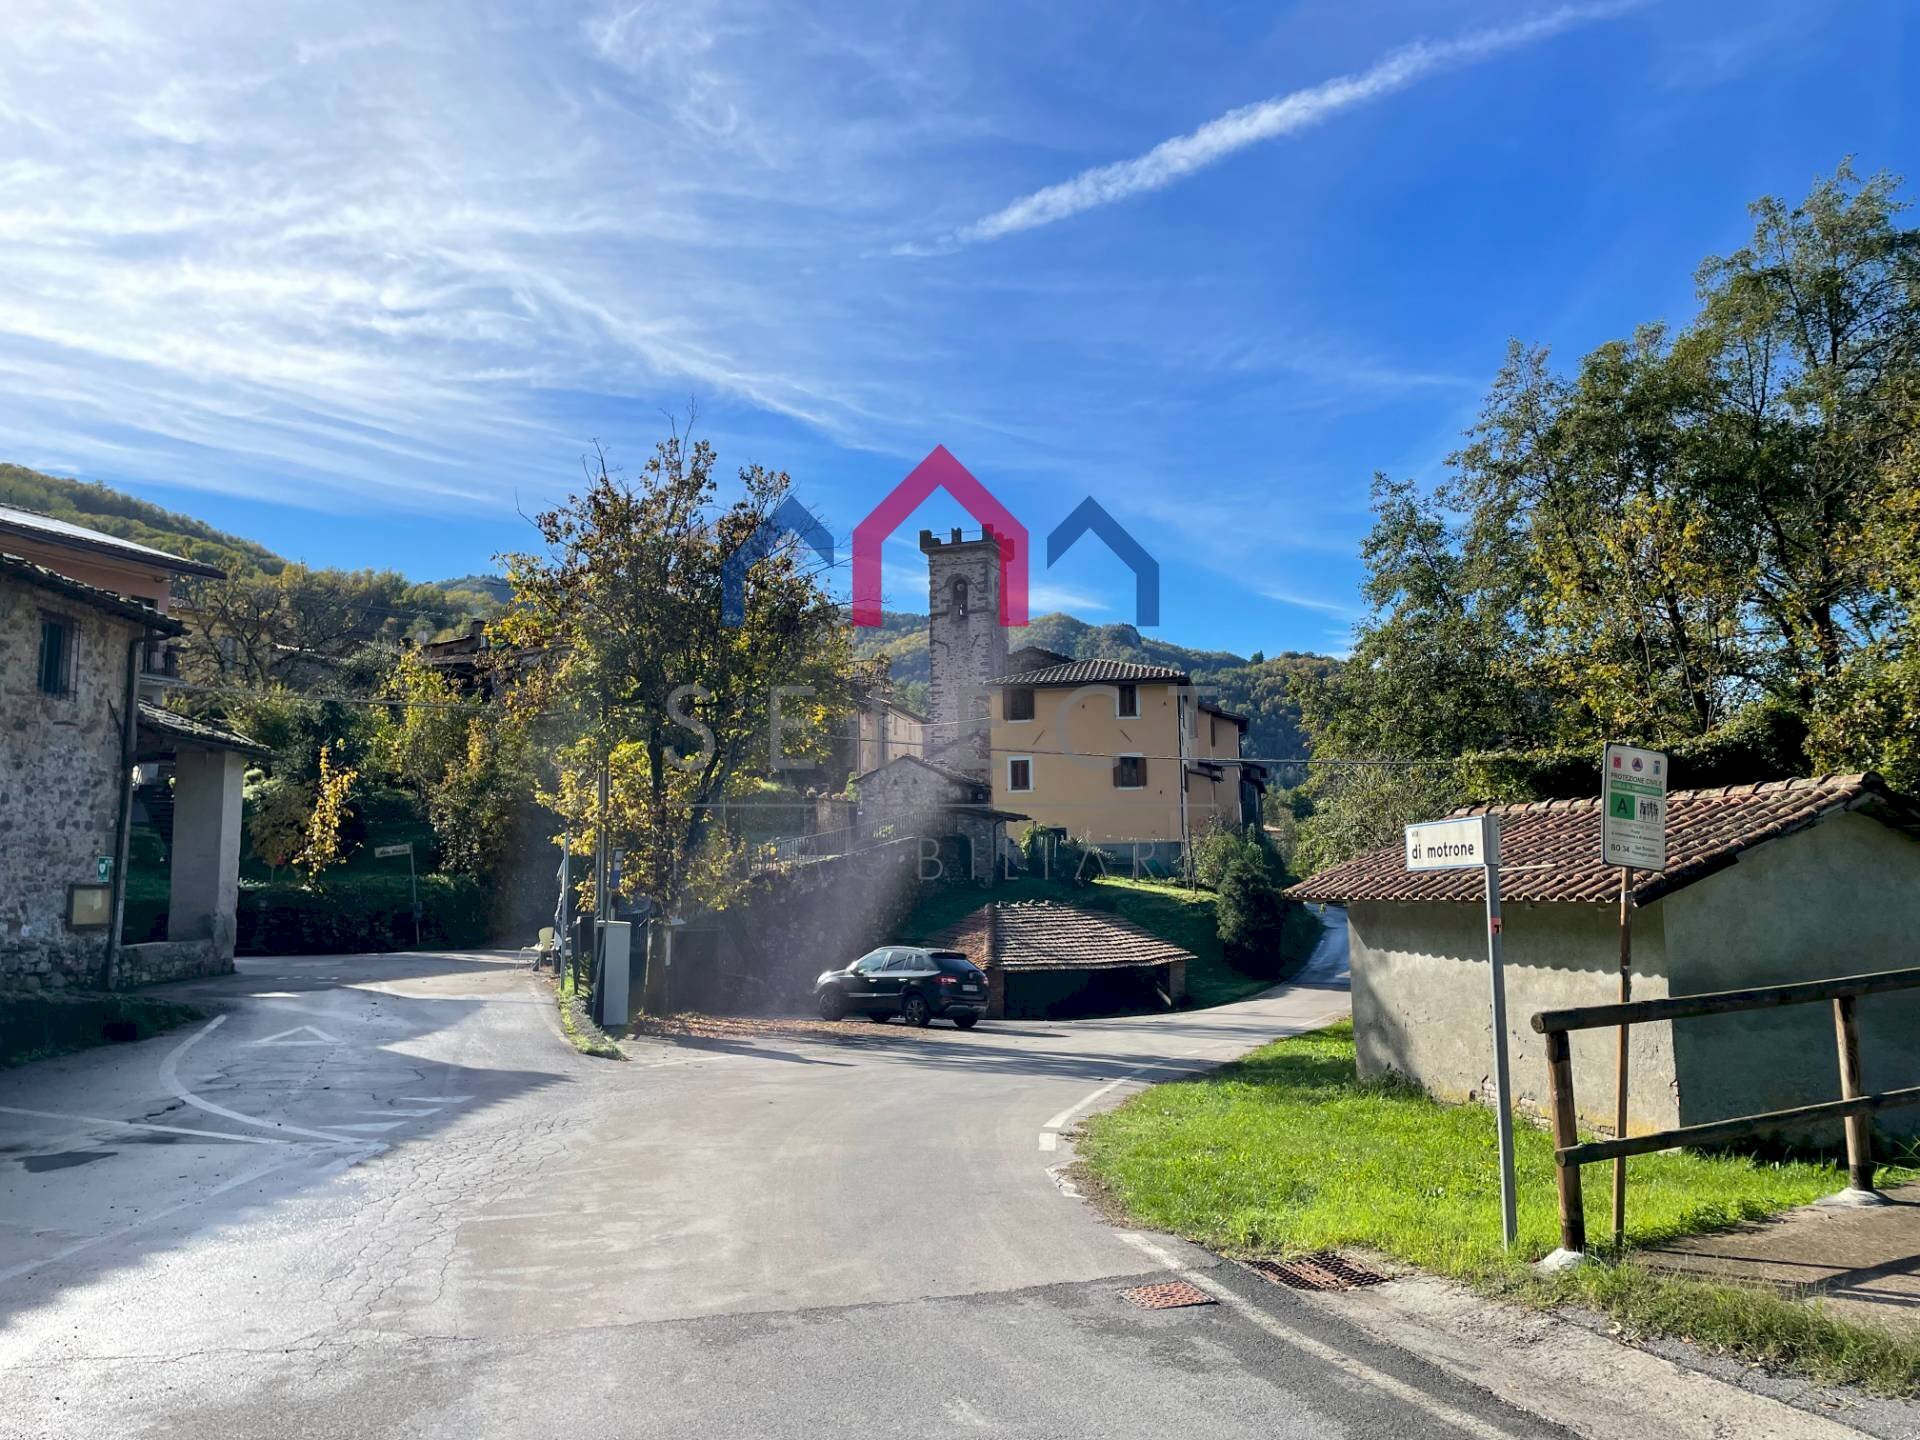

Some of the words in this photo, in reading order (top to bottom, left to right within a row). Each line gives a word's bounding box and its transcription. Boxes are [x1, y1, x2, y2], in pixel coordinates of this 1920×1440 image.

[1617, 798, 1628, 814] A
[1412, 843, 1421, 859] di
[1427, 842, 1474, 858] motrone
